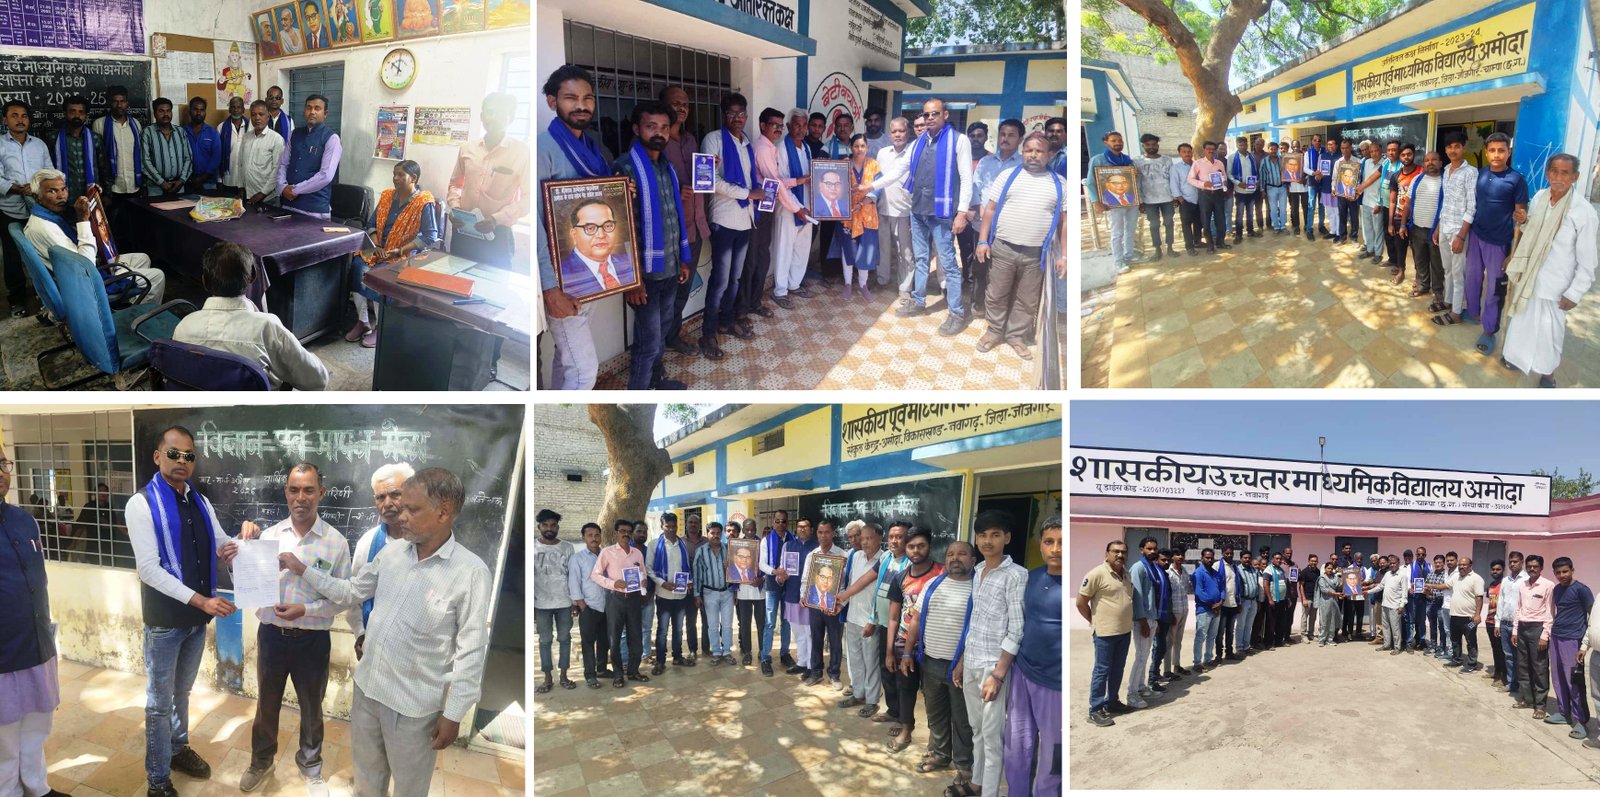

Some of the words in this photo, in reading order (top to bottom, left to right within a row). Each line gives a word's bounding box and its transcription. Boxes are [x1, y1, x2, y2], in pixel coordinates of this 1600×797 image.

[1383, 65, 1395, 87] पूर्व
[1394, 58, 1434, 82] माध्यमिक
[1478, 29, 1528, 62] अमोदा
[47, 91, 80, 105] 20
[822, 78, 842, 107] बेटी
[197, 420, 268, 461] विज्ञान
[842, 407, 889, 444] शासकीय
[1070, 455, 1208, 484] शासकीय
[1208, 465, 1292, 491] उच्चतर
[1291, 467, 1391, 494] माध्यमिक
[1391, 471, 1463, 498] विद्यालय
[1464, 476, 1525, 505] अमोदा
